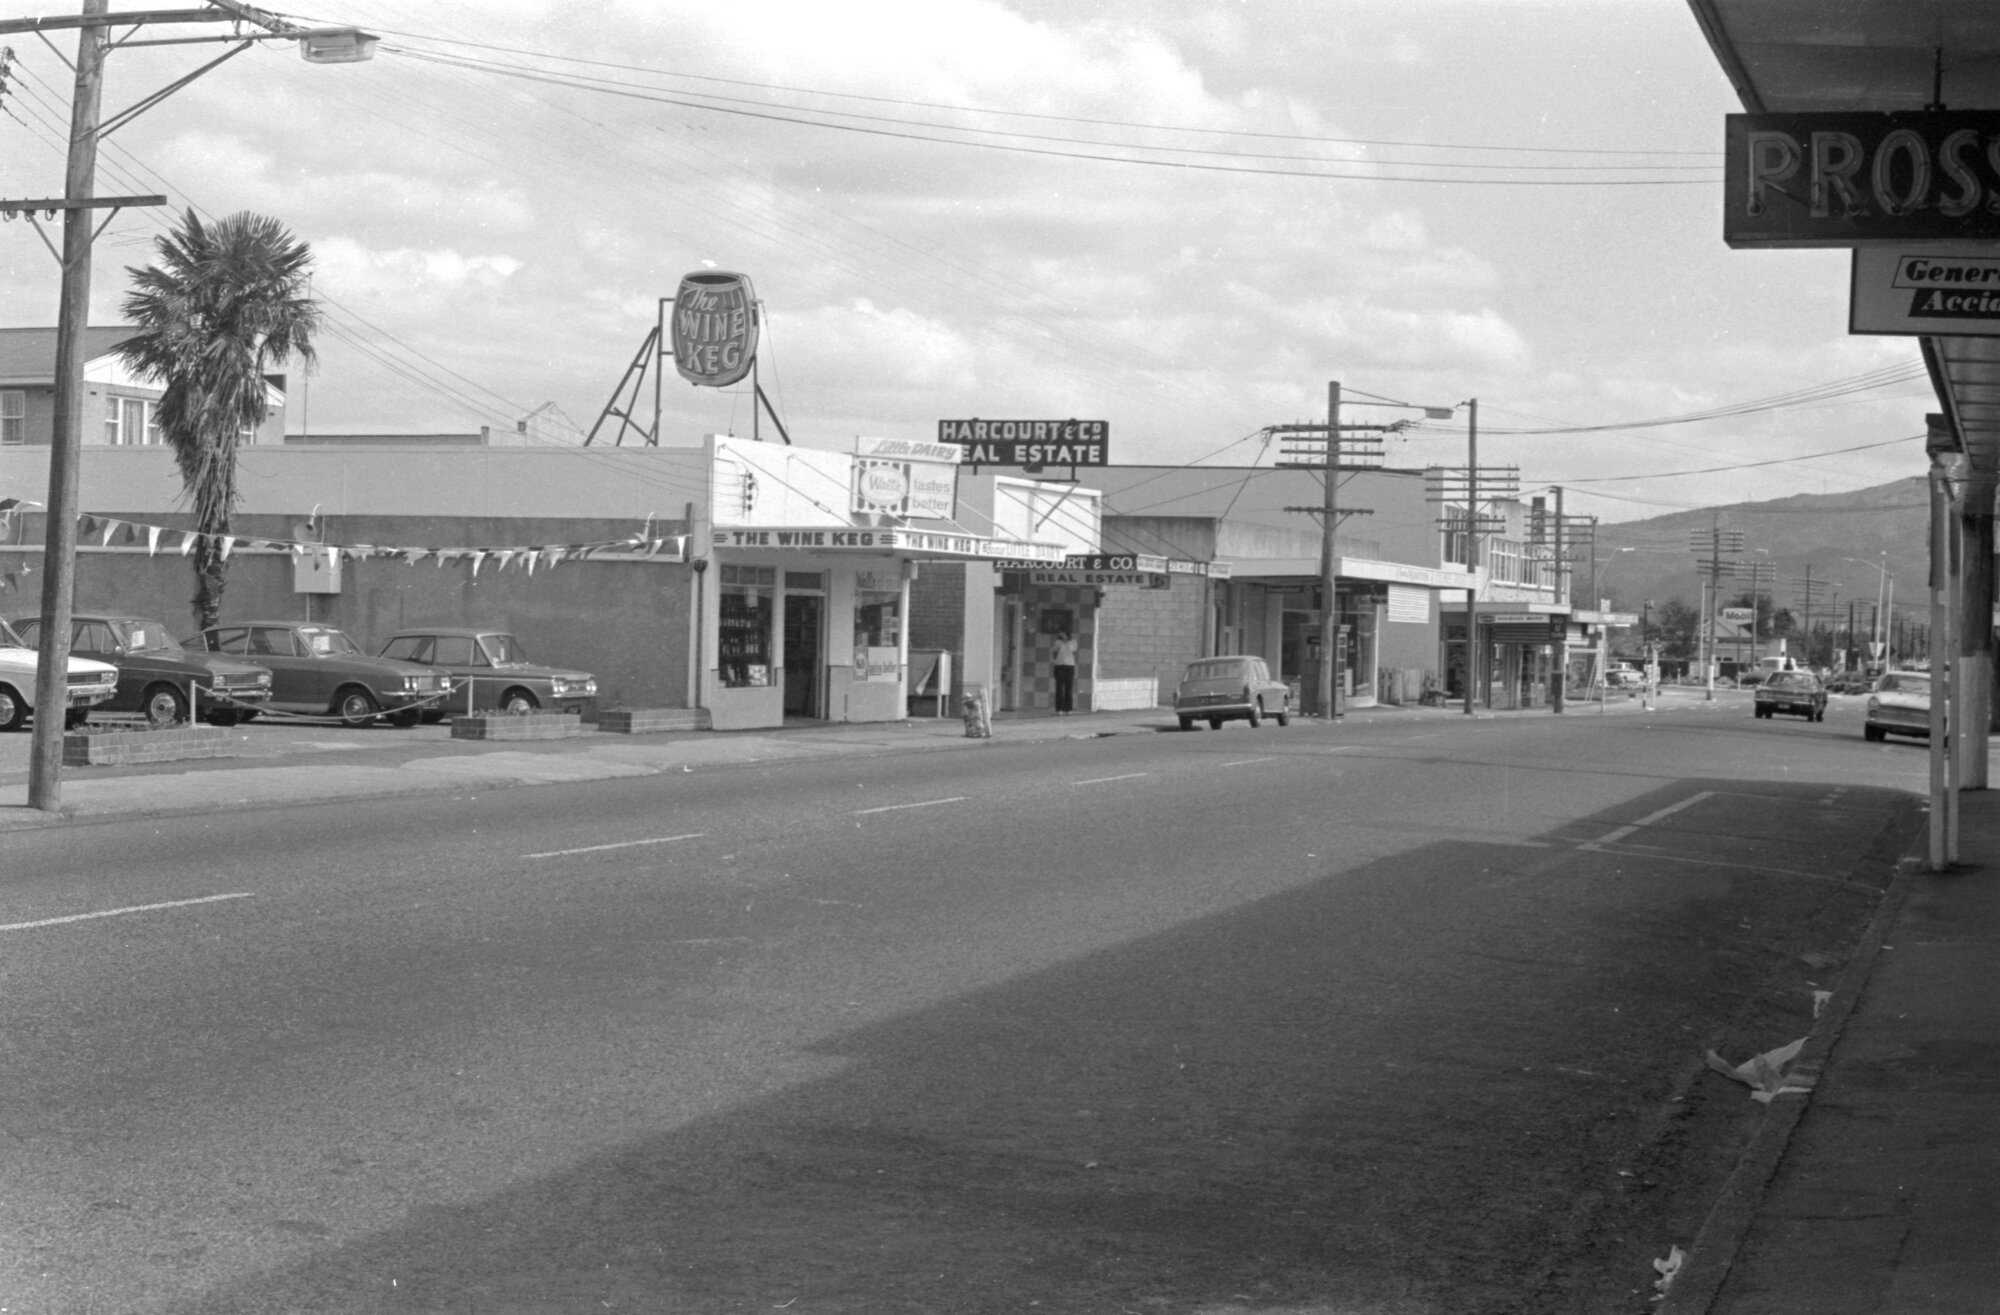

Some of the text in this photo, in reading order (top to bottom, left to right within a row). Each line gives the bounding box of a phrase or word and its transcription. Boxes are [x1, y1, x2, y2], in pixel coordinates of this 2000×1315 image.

[1906, 259, 2000, 282] Gener
[680, 287, 719, 311] The
[681, 307, 744, 342] WINE
[687, 342, 740, 374] KEG
[942, 422, 1061, 440] HARCOURT
[911, 443, 958, 461] DAIRY
[961, 445, 1100, 463] EAL ESTATE
[913, 480, 951, 493] tastes
[912, 496, 951, 510] better
[733, 532, 874, 546] THE WINE KEG
[905, 534, 923, 548] THE
[927, 536, 949, 551] WINE
[954, 538, 971, 553] KEG
[1093, 557, 1102, 569] &
[1036, 573, 1077, 583] REAL
[1085, 573, 1145, 584] ESTATE
